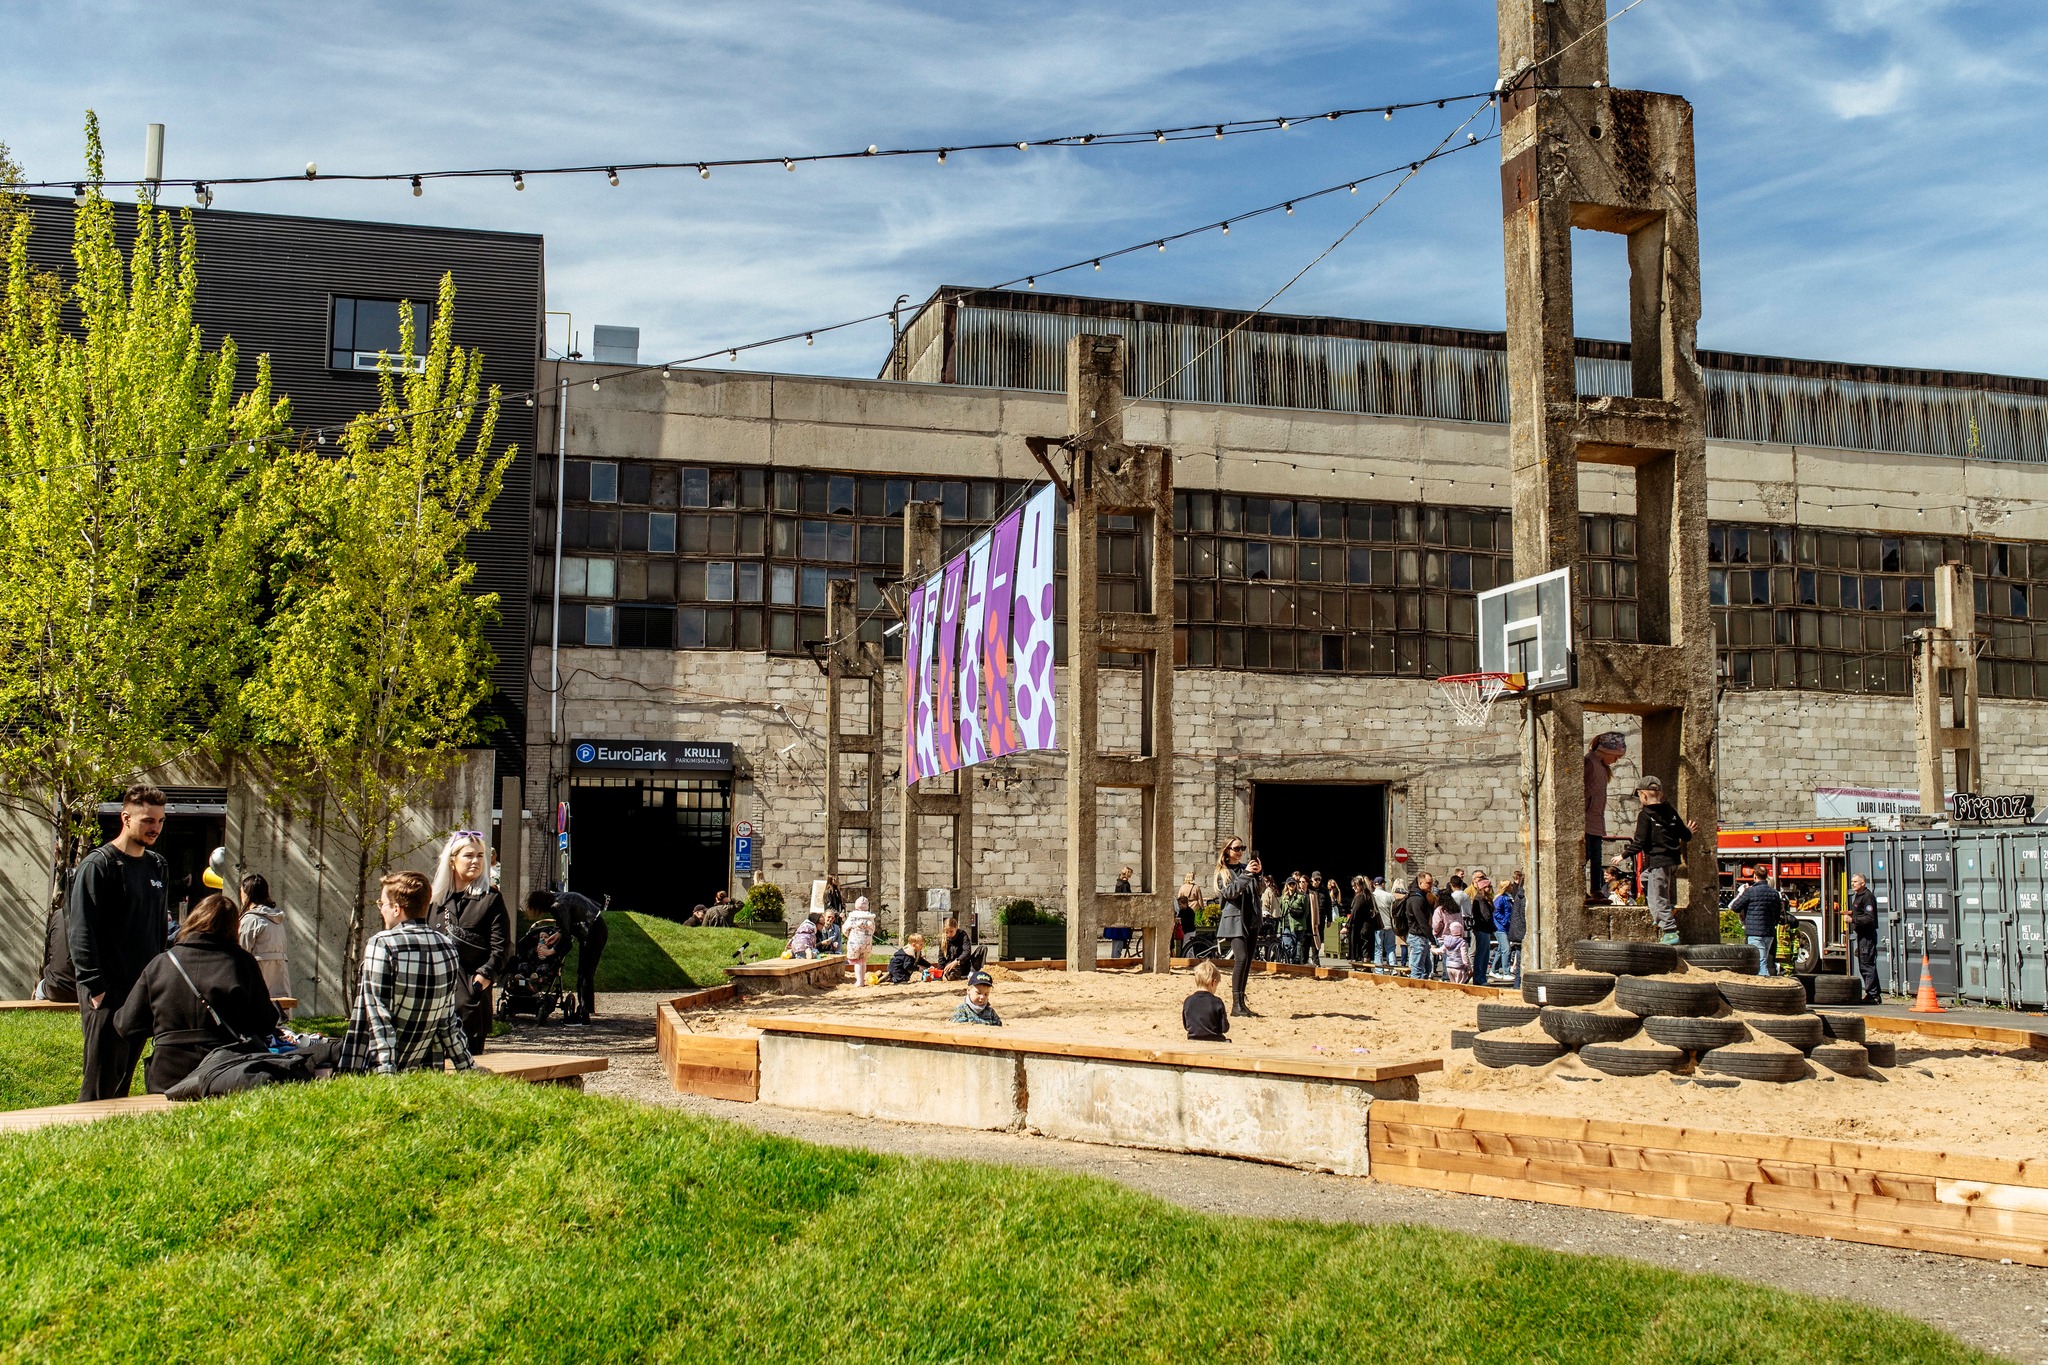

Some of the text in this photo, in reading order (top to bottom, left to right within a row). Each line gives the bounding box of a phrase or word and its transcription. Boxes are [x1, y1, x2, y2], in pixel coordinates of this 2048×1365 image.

[908, 511, 1041, 650] KRULLI
[598, 747, 667, 761] EuroPark
[684, 748, 721, 758] KRULLI
[1857, 802, 1876, 813] LAURI
[1878, 802, 1896, 814] LAGLE
[1953, 793, 2028, 820] Franz
[739, 840, 748, 853] P
